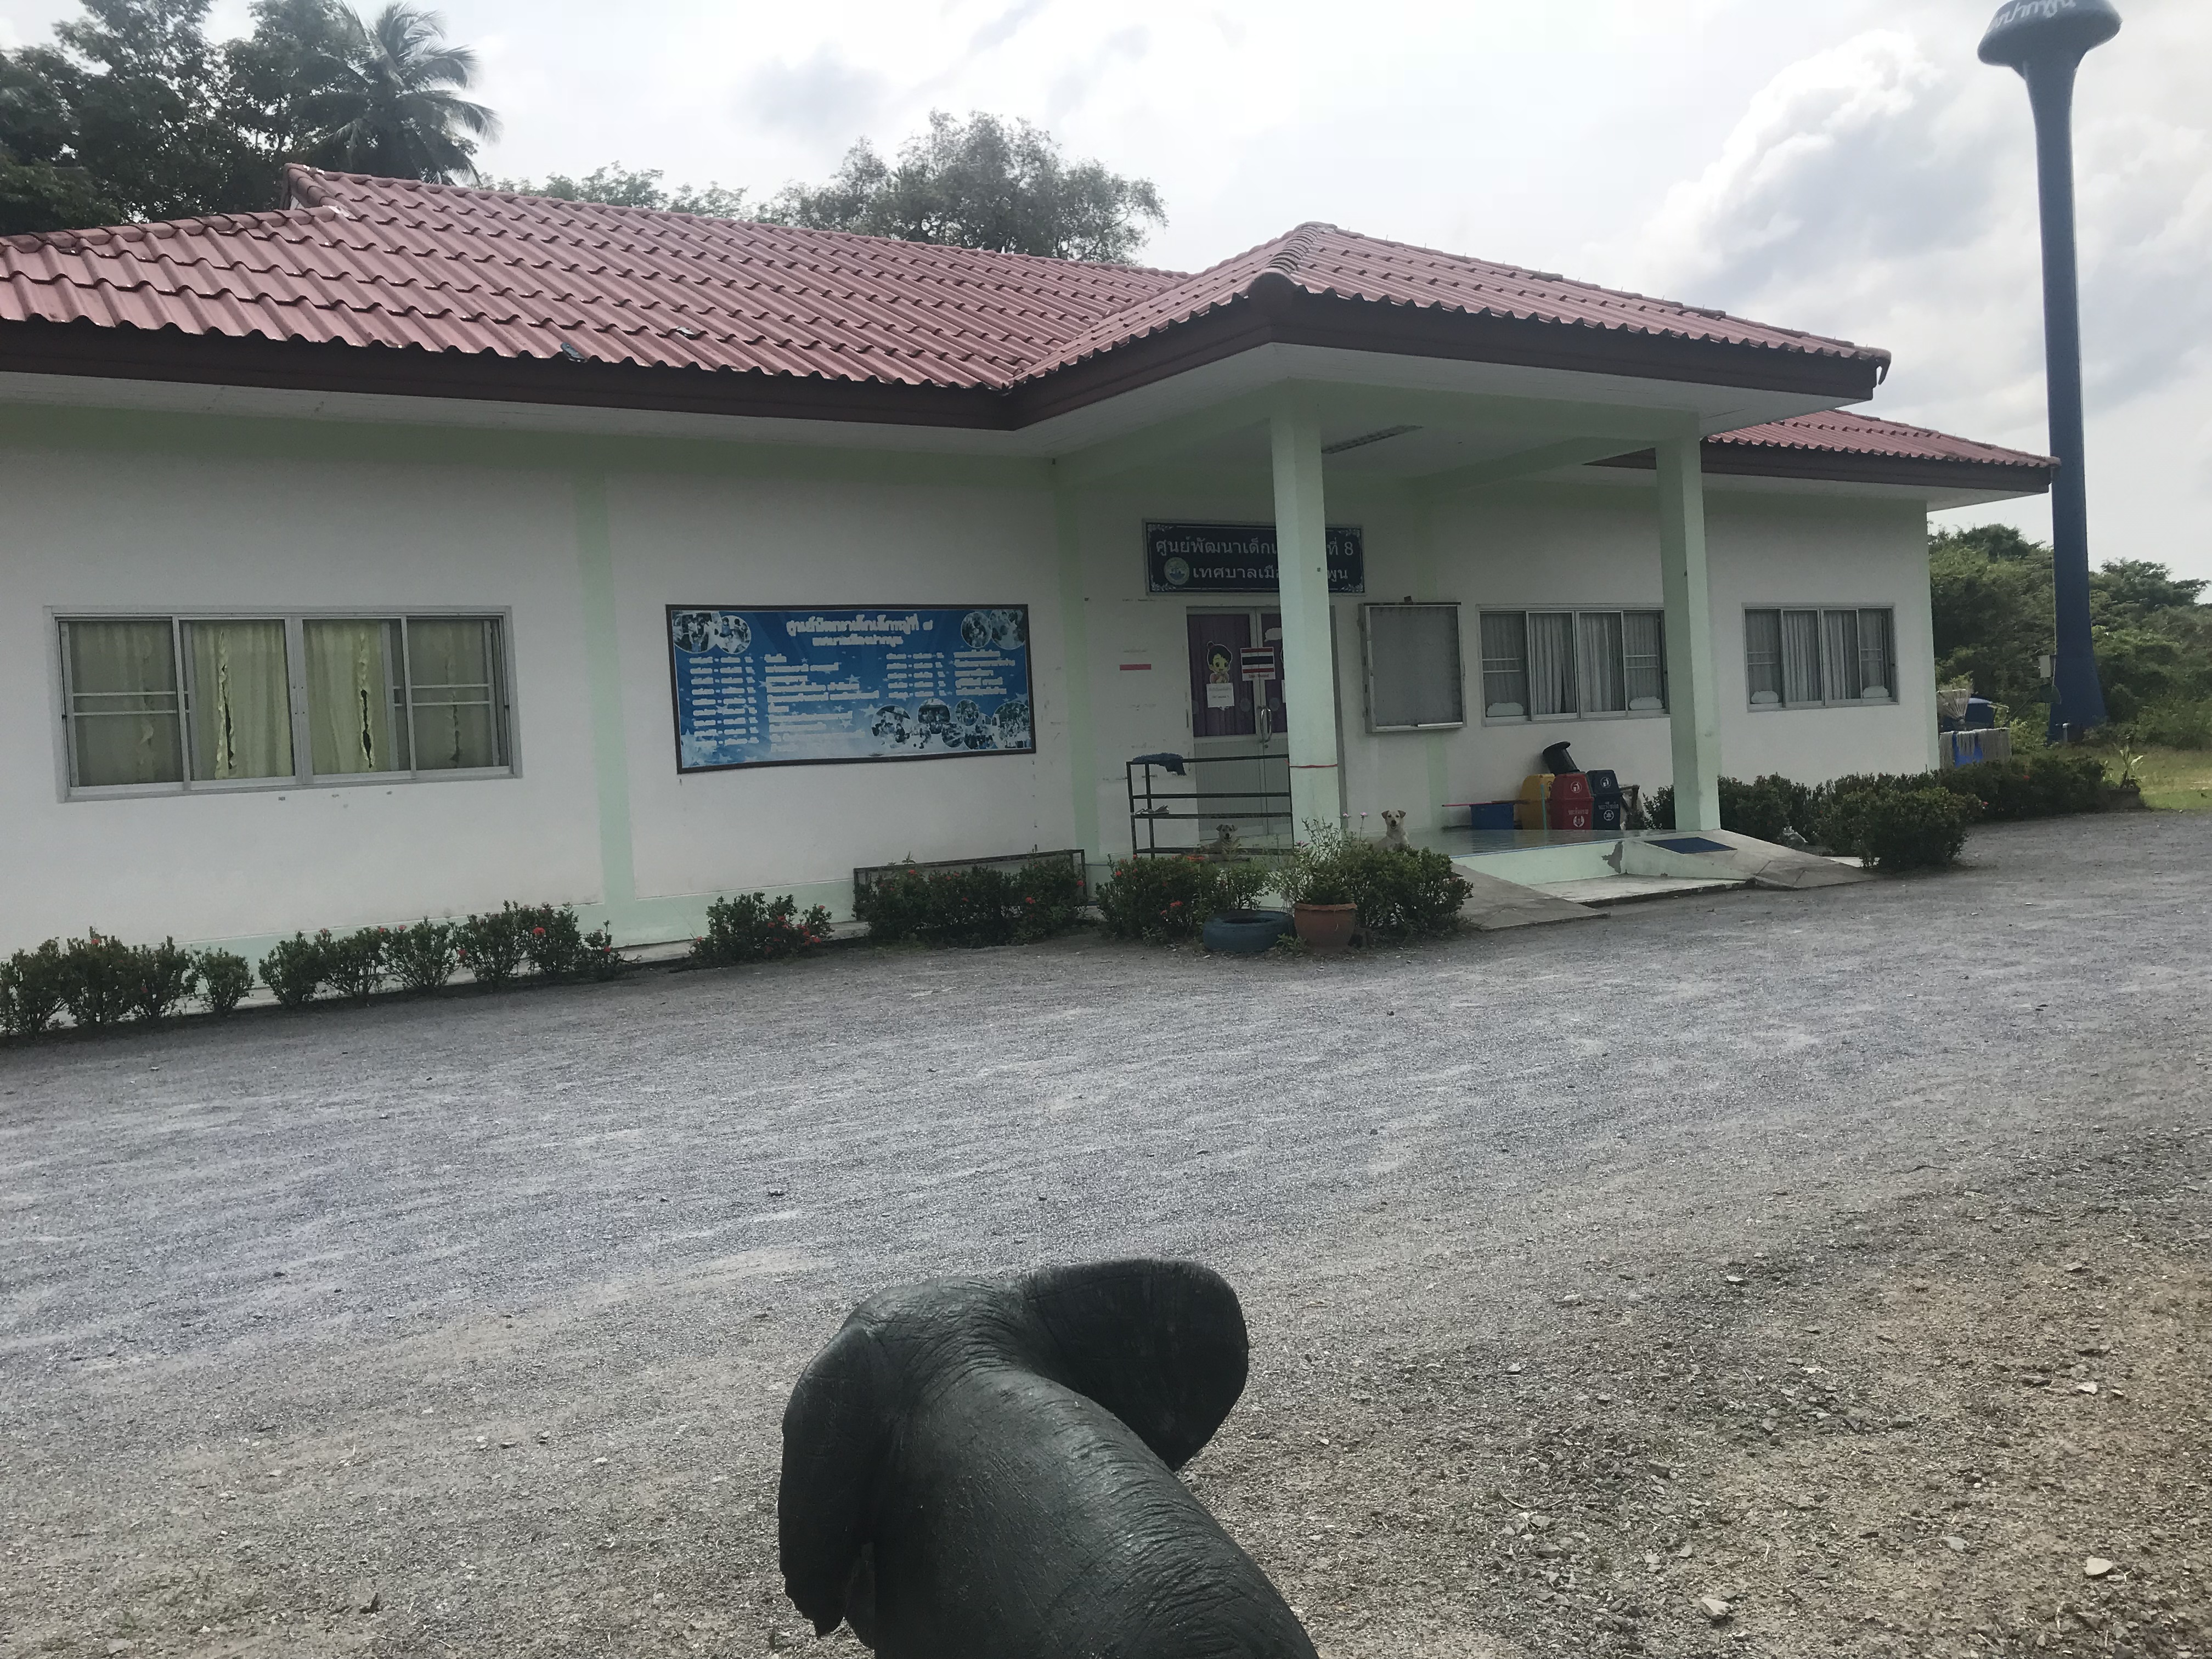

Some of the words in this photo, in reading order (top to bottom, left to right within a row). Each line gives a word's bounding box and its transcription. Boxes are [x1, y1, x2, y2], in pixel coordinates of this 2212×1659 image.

[1155, 535, 1339, 556] ศูนย์พัฒนาเด็กเที่
[1344, 541, 1353, 556] 8
[1192, 565, 1348, 582] เทศบาลเมืพูน
